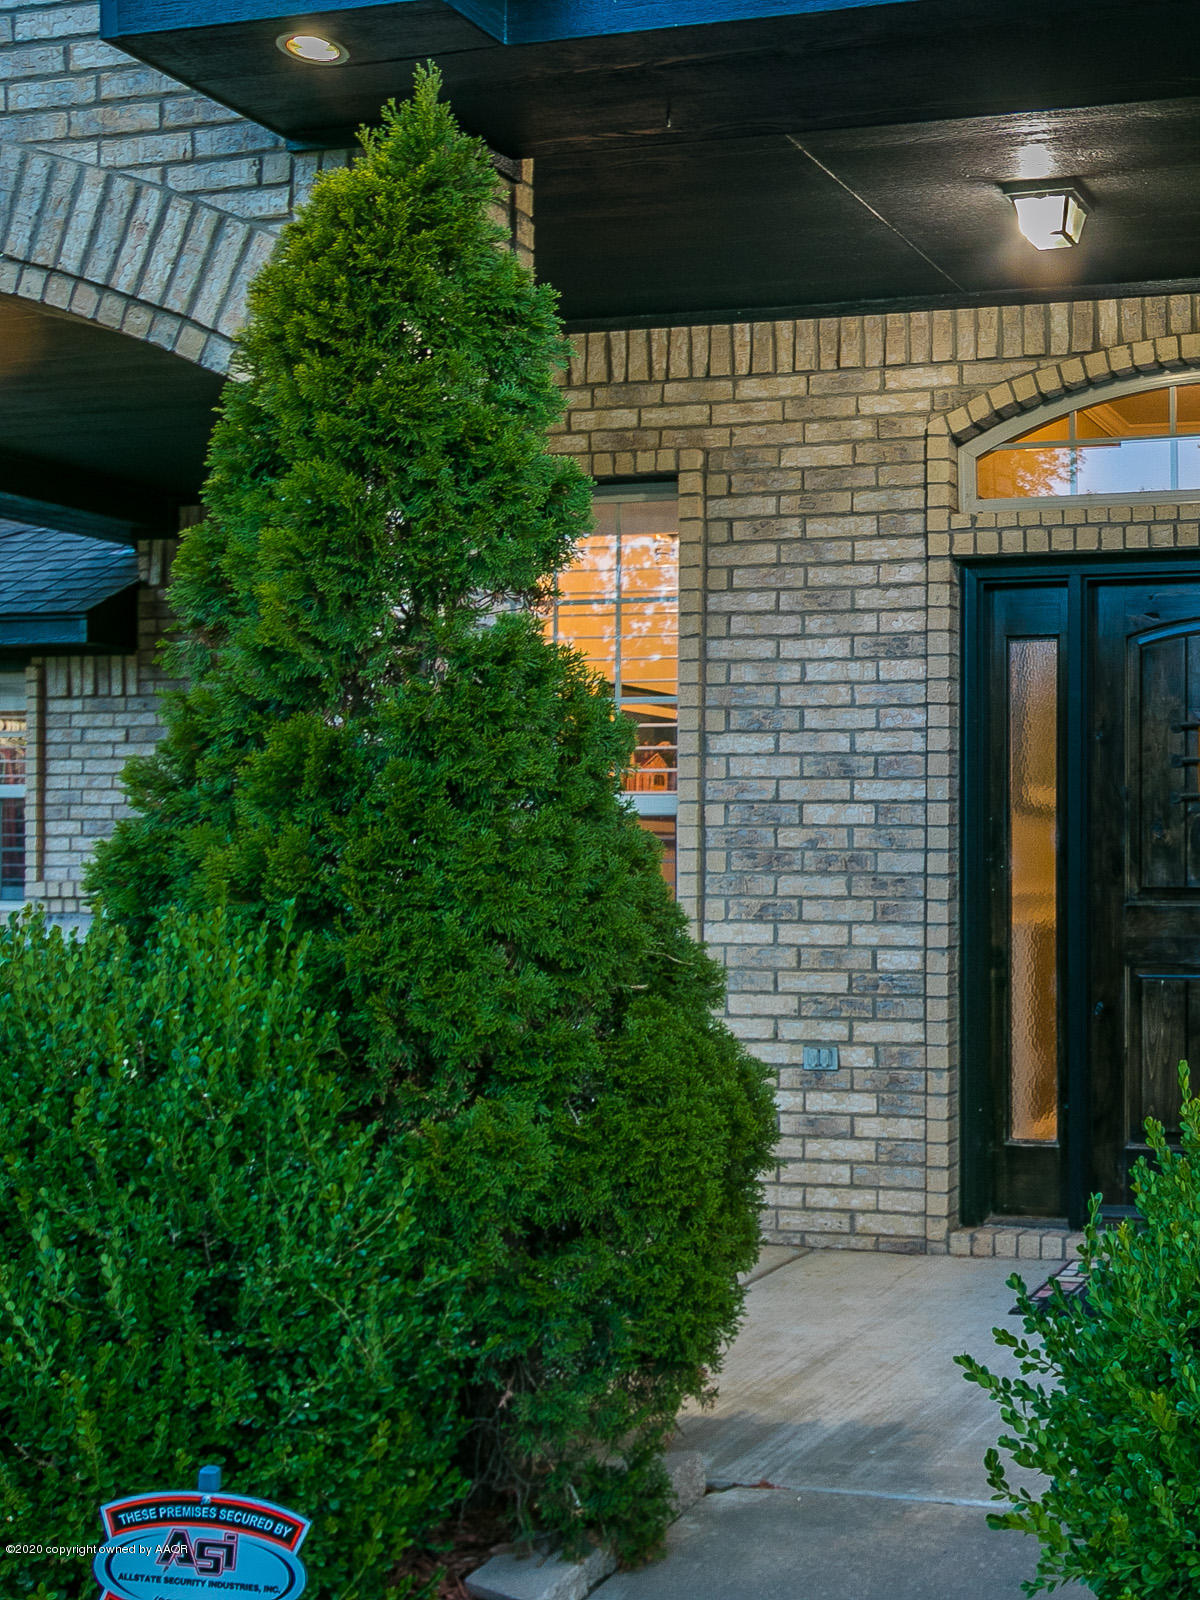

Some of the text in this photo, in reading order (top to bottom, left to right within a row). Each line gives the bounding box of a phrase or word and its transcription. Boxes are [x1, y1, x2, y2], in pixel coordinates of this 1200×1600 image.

[118, 1505, 293, 1538] THESE PREMISES SECURED BY
[118, 1572, 281, 1594] ALLSTATE SECURITY INDUSTRIES, INC.
